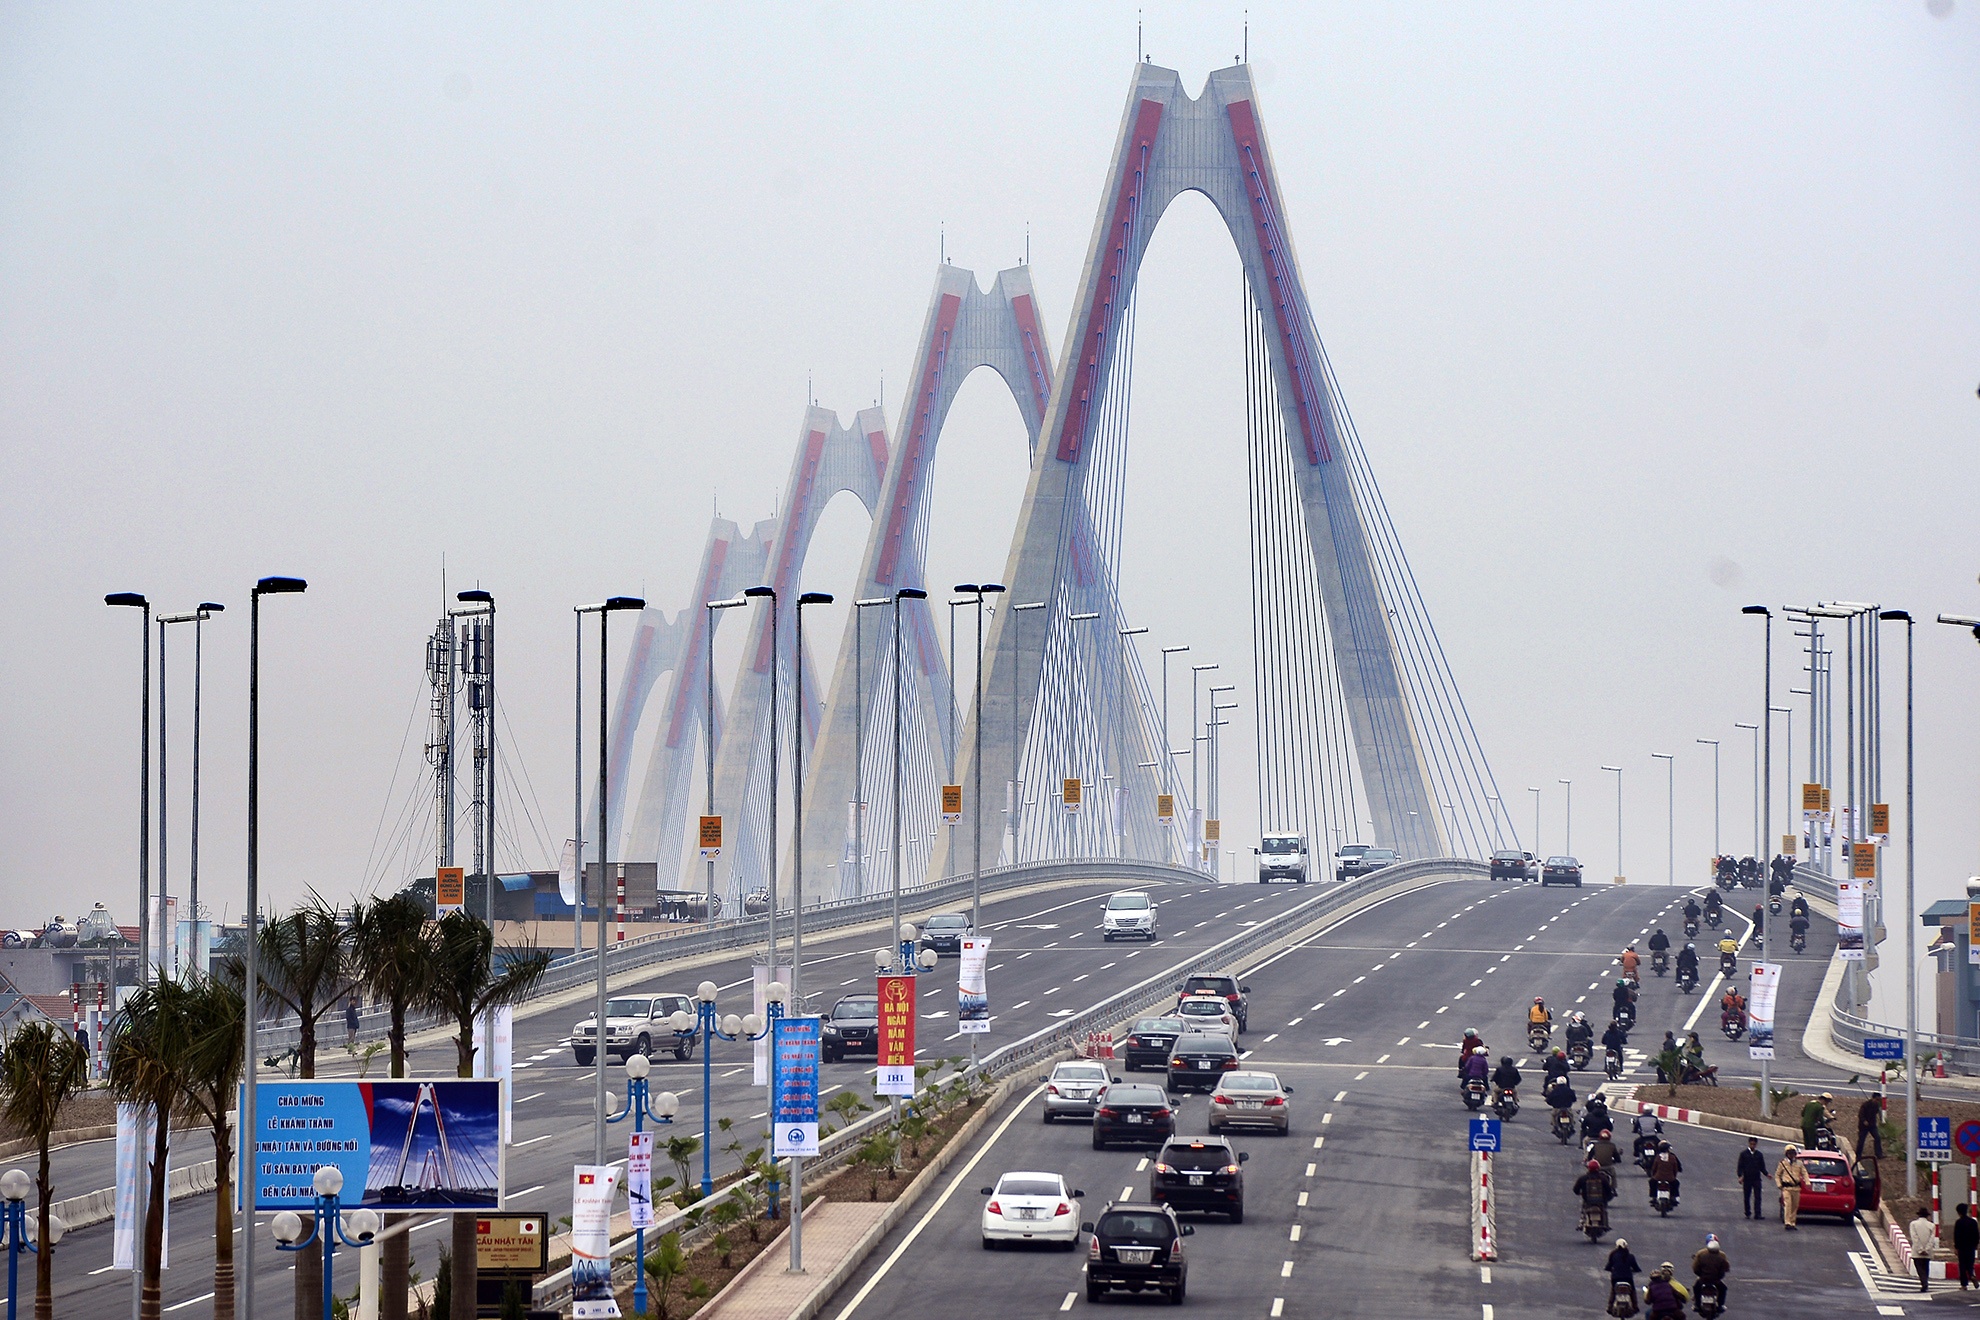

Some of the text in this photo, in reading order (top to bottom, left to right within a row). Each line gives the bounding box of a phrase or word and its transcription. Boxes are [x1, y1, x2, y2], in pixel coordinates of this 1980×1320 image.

[885, 1001, 909, 1014] HÀ NỘI
[887, 1014, 906, 1025] NGÀN
[888, 1027, 905, 1038] NĂM
[889, 1041, 904, 1051] VĂN
[278, 1094, 324, 1106] CHÀO MỪNG
[268, 1116, 334, 1129] LỄ KHÁNH THÀNH
[262, 1140, 282, 1154] NHẬT
[285, 1140, 300, 1151] TÂN
[302, 1140, 313, 1151] VÀ
[316, 1139, 342, 1151] ĐƯỜNG
[344, 1138, 358, 1151] NỐI
[262, 1162, 272, 1174] TỪ
[274, 1163, 290, 1174] SÂN
[292, 1164, 307, 1174] BAY
[262, 1184, 279, 1197] ĐẾN
[281, 1184, 297, 1197] CẦU
[477, 1236, 534, 1246] CẦU NHẬT TÂN
